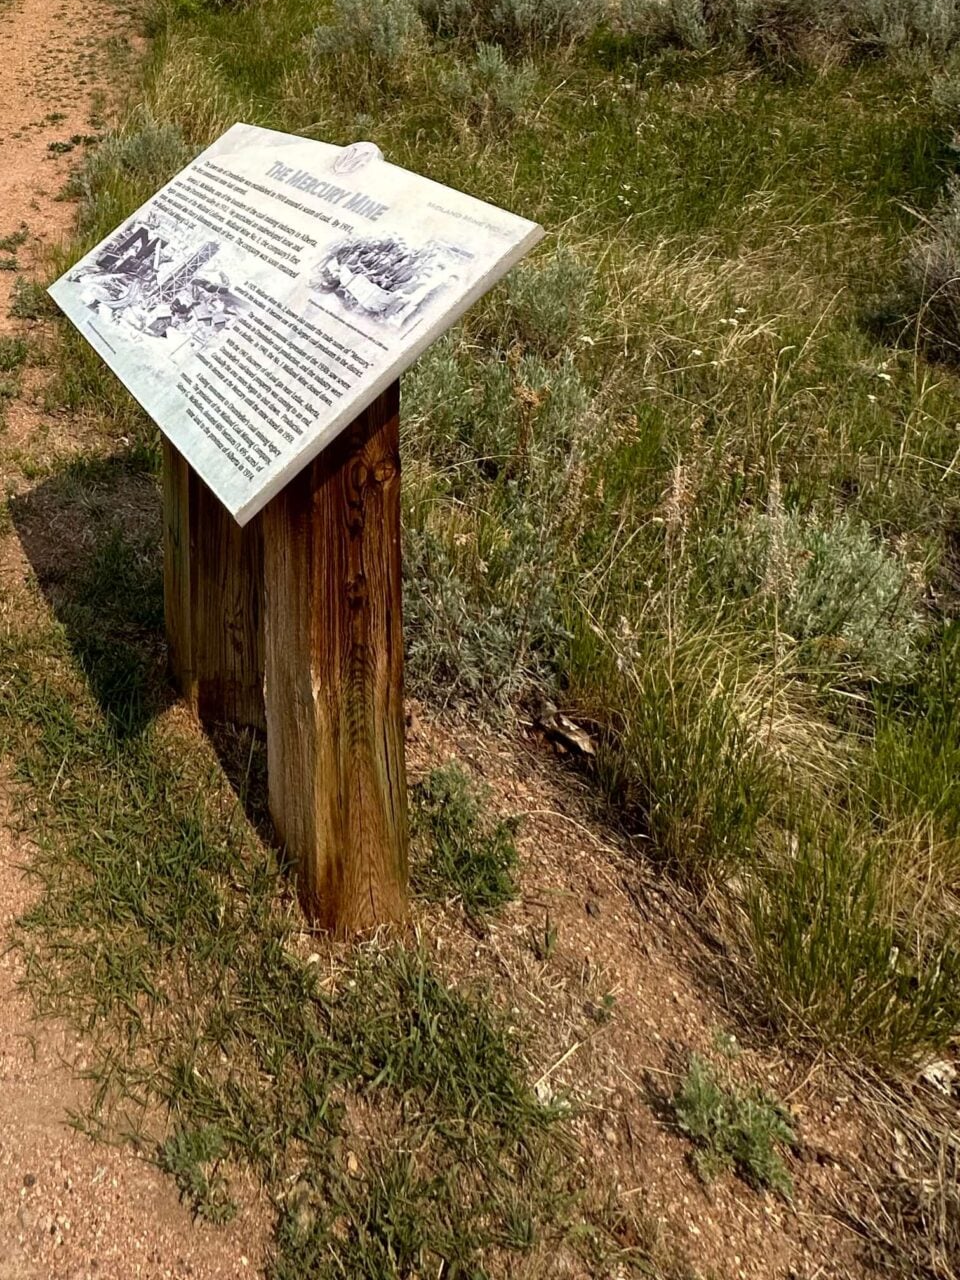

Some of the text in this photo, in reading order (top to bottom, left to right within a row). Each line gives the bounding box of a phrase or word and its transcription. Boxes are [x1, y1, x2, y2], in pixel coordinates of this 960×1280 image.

[265, 160, 294, 182] THE
[285, 169, 352, 205] MERCURY
[342, 192, 389, 222] MINE
[302, 206, 316, 214] seam
[261, 215, 281, 227] mining
[298, 233, 321, 247] Alberta,
[239, 242, 261, 256] company
[276, 262, 300, 278] renamed
[265, 242, 293, 260] company's
[288, 254, 302, 264] first
[295, 328, 311, 341] largest
[315, 342, 338, 359] producers
[346, 363, 365, 377] district.
[320, 332, 335, 343] trade
[281, 363, 300, 378] Midland
[296, 375, 310, 386] Mine
[306, 382, 322, 396] closed
[318, 392, 335, 406] down.
[312, 373, 333, 390] industry
[330, 386, 344, 398] went
[335, 377, 351, 389] severe
[230, 384, 247, 400] Mercury
[257, 408, 269, 419] mine
[265, 416, 281, 430] closed
[244, 383, 259, 396] began
[260, 395, 271, 406] shut
[280, 413, 305, 435] Production
[275, 395, 294, 411] coming
[300, 415, 313, 427] end.
[281, 385, 293, 395] near
[302, 402, 322, 419] Alberta,
[206, 431, 225, 450] province
[225, 449, 241, 466] Alberta
[219, 410, 236, 427] Midland
[232, 423, 244, 434] Coal
[238, 431, 256, 448] Mining
[250, 443, 274, 466] Company,
[247, 421, 258, 432] coal
[253, 429, 271, 446] mining
[265, 441, 282, 457] legacy
